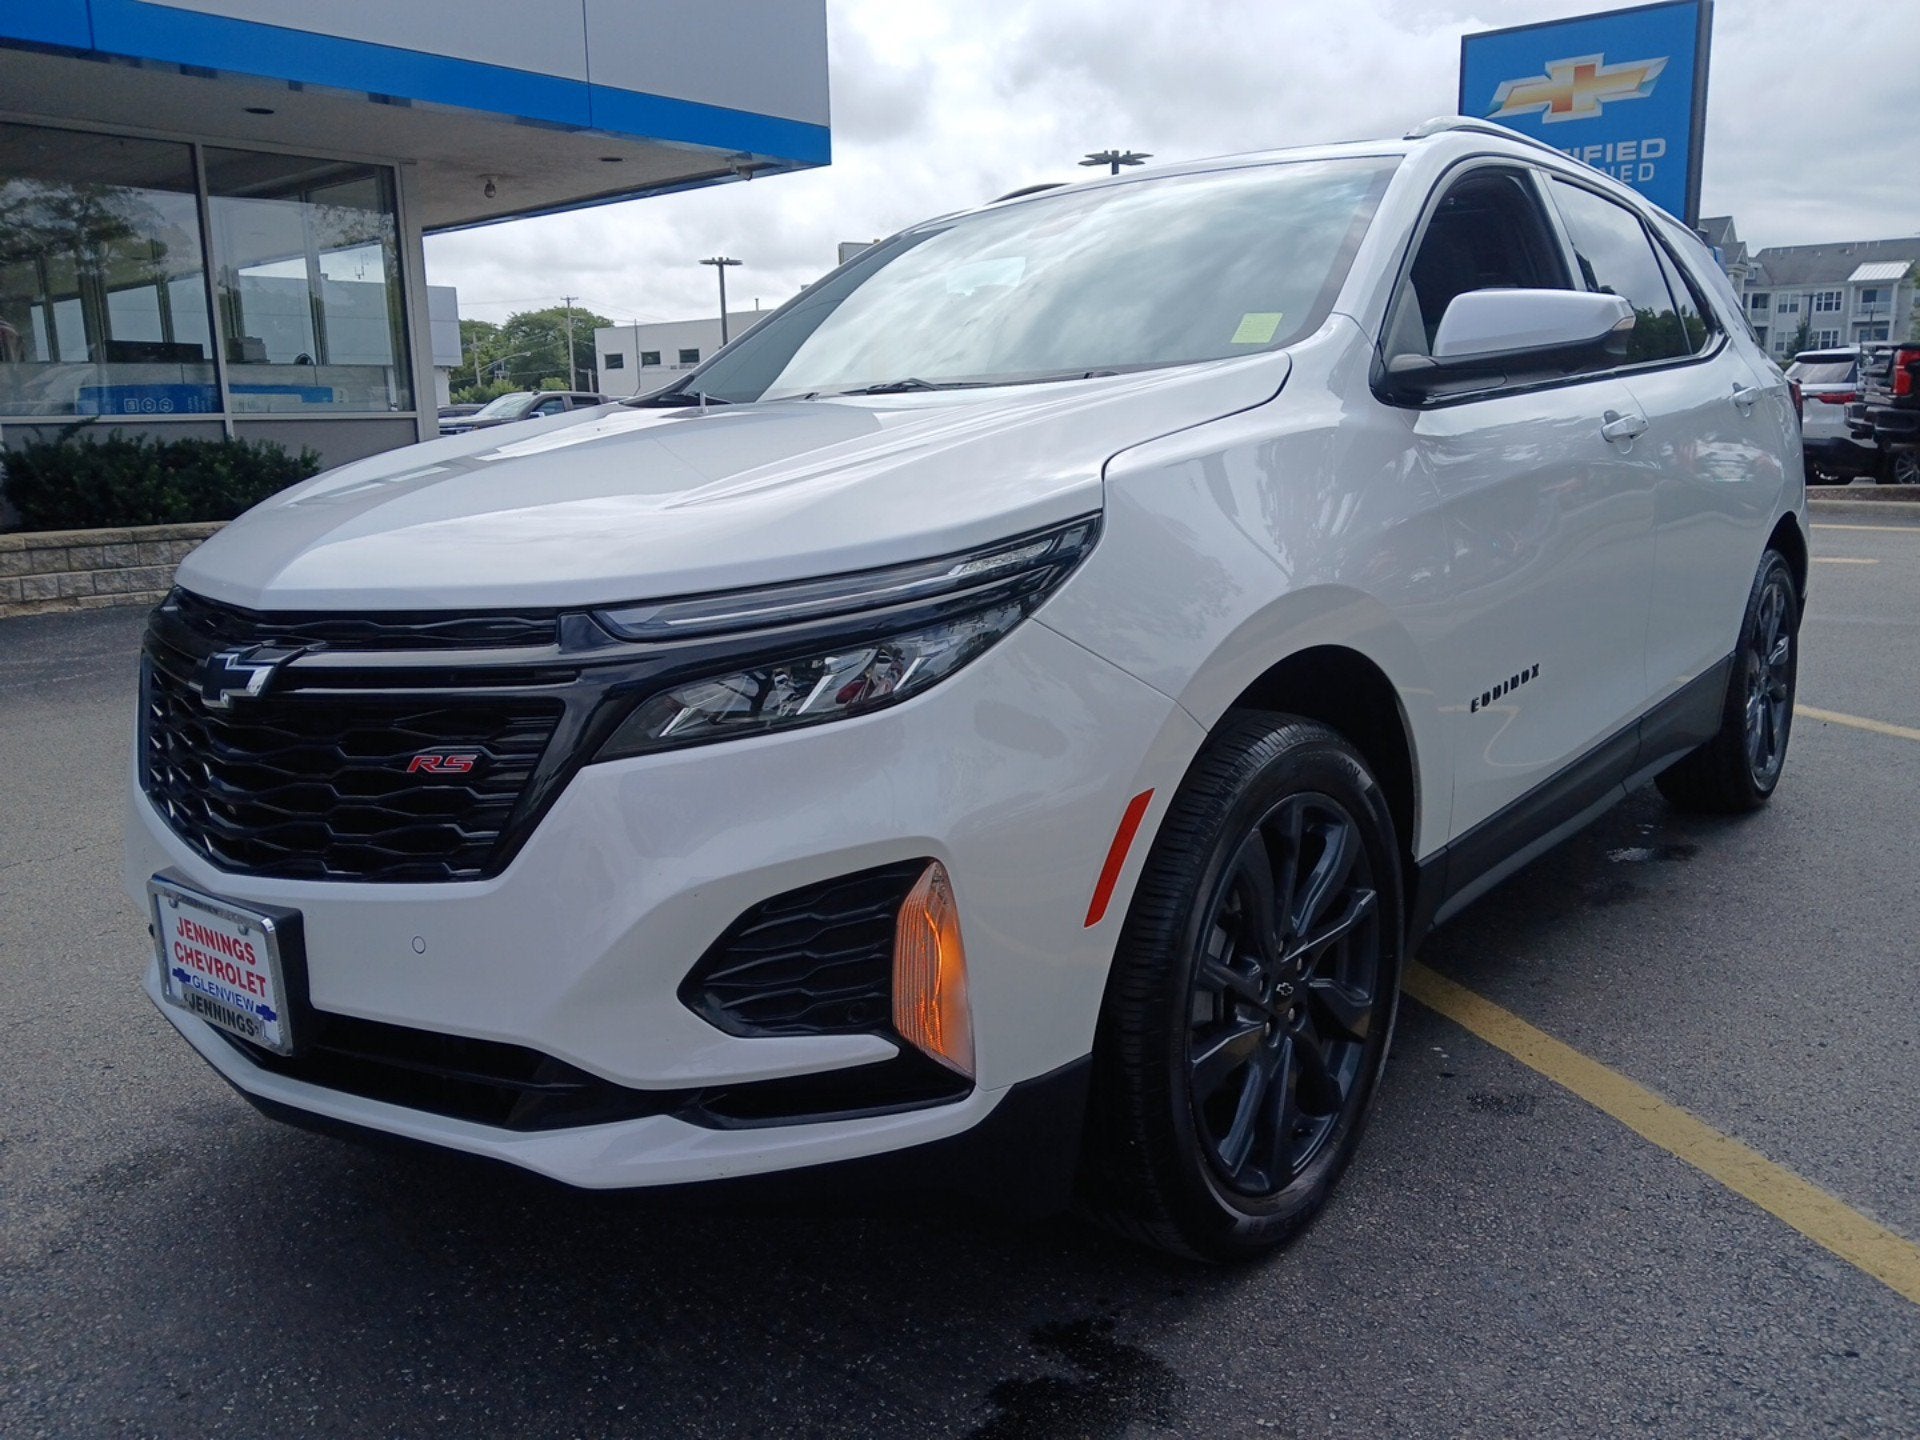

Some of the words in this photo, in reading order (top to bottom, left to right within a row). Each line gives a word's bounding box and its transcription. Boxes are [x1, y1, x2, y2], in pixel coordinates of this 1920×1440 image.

[1561, 138, 1666, 164] IFIED
[1470, 663, 1540, 714] EQUINOX
[406, 754, 478, 773] RS
[177, 917, 256, 965] JENNINGS
[174, 941, 266, 998] CHEVROLET
[188, 993, 255, 1036] JENNINGS
[191, 975, 255, 1012] GLENVIEW
